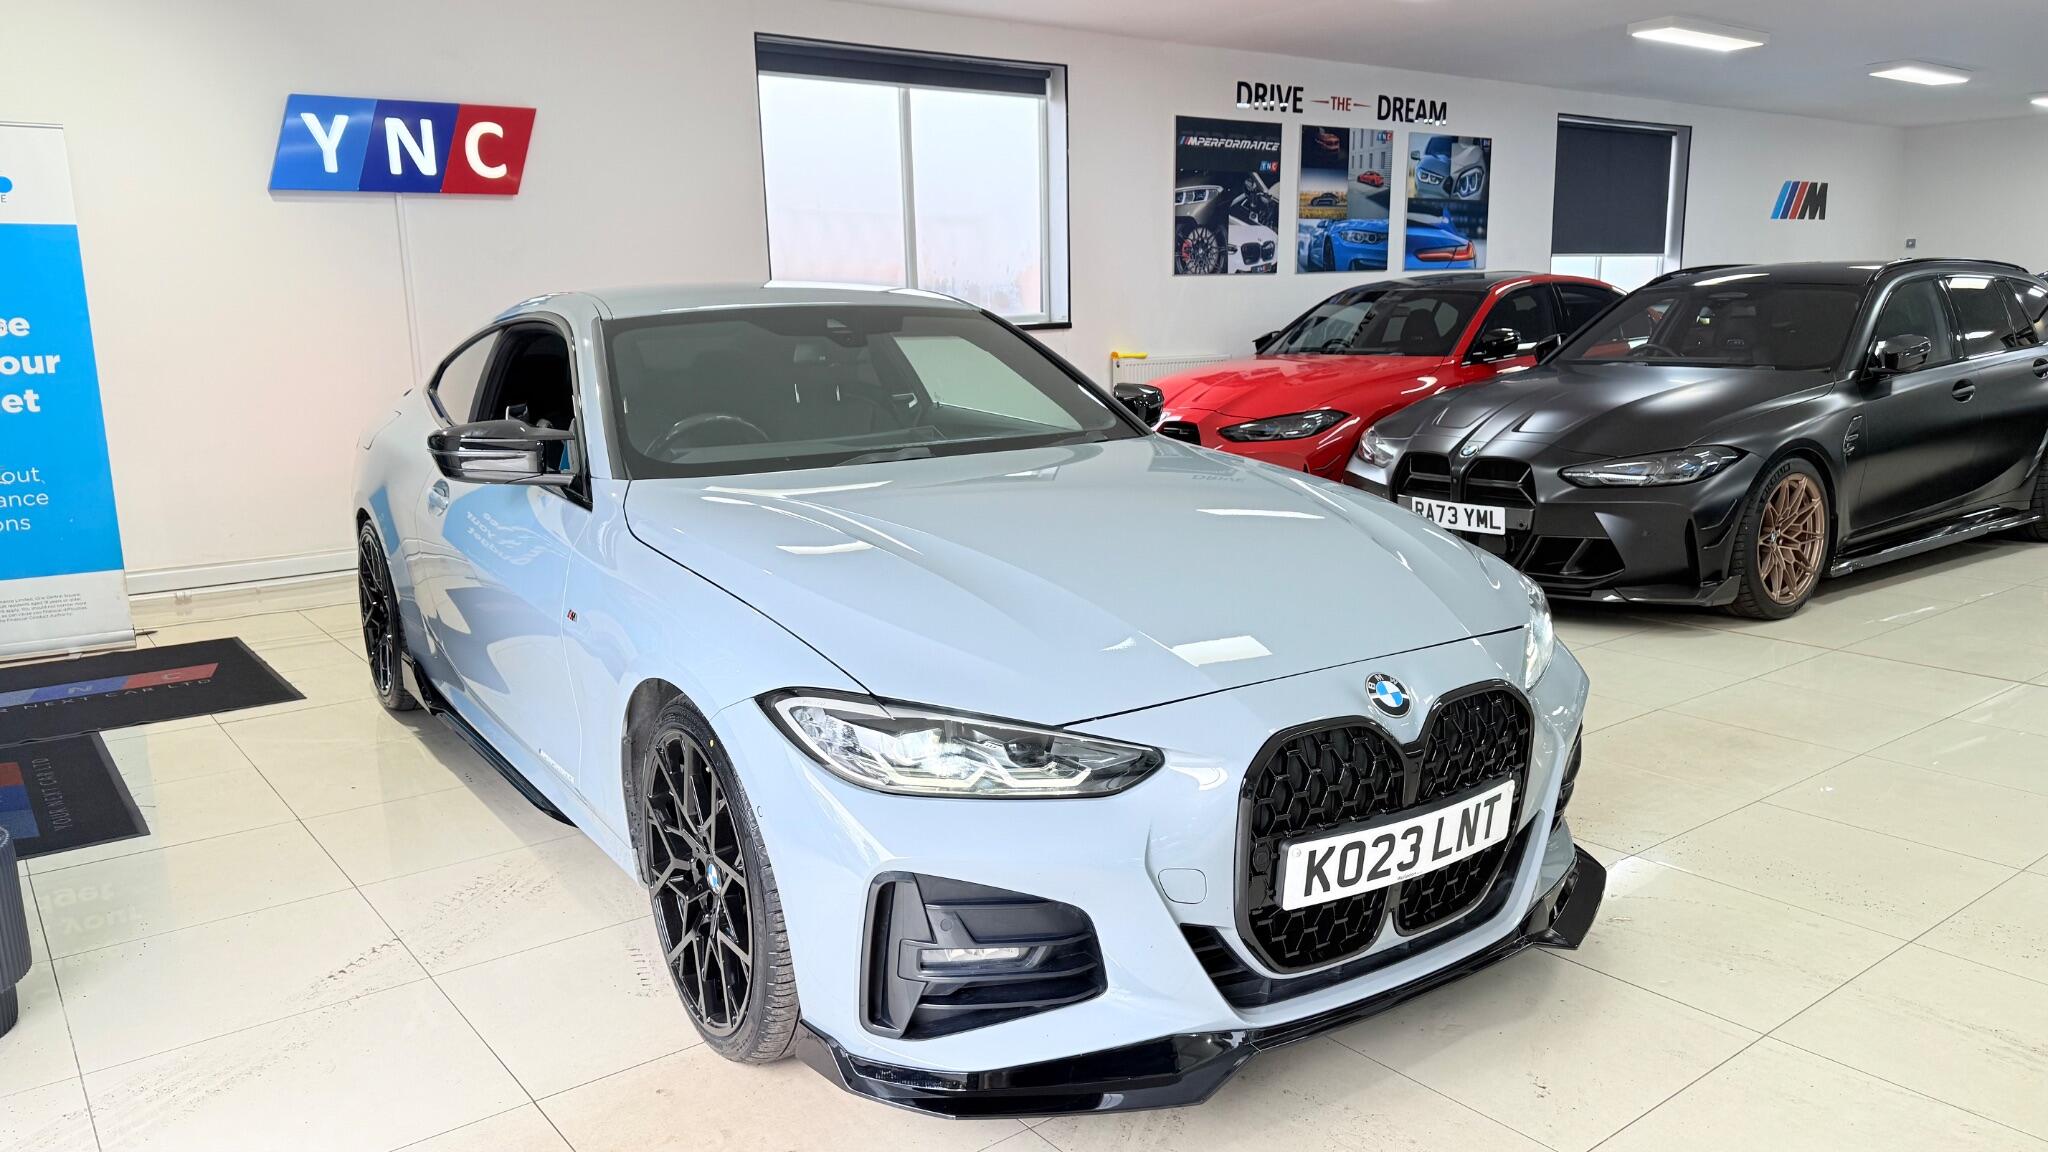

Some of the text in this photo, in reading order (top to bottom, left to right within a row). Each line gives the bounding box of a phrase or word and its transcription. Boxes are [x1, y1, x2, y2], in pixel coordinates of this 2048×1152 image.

[1236, 81, 1448, 126] DRIVE THE DREAM
[300, 112, 508, 179] YNC
[1415, 501, 1502, 530] RA73 YML
[1303, 792, 1502, 898] KO23 LNT
